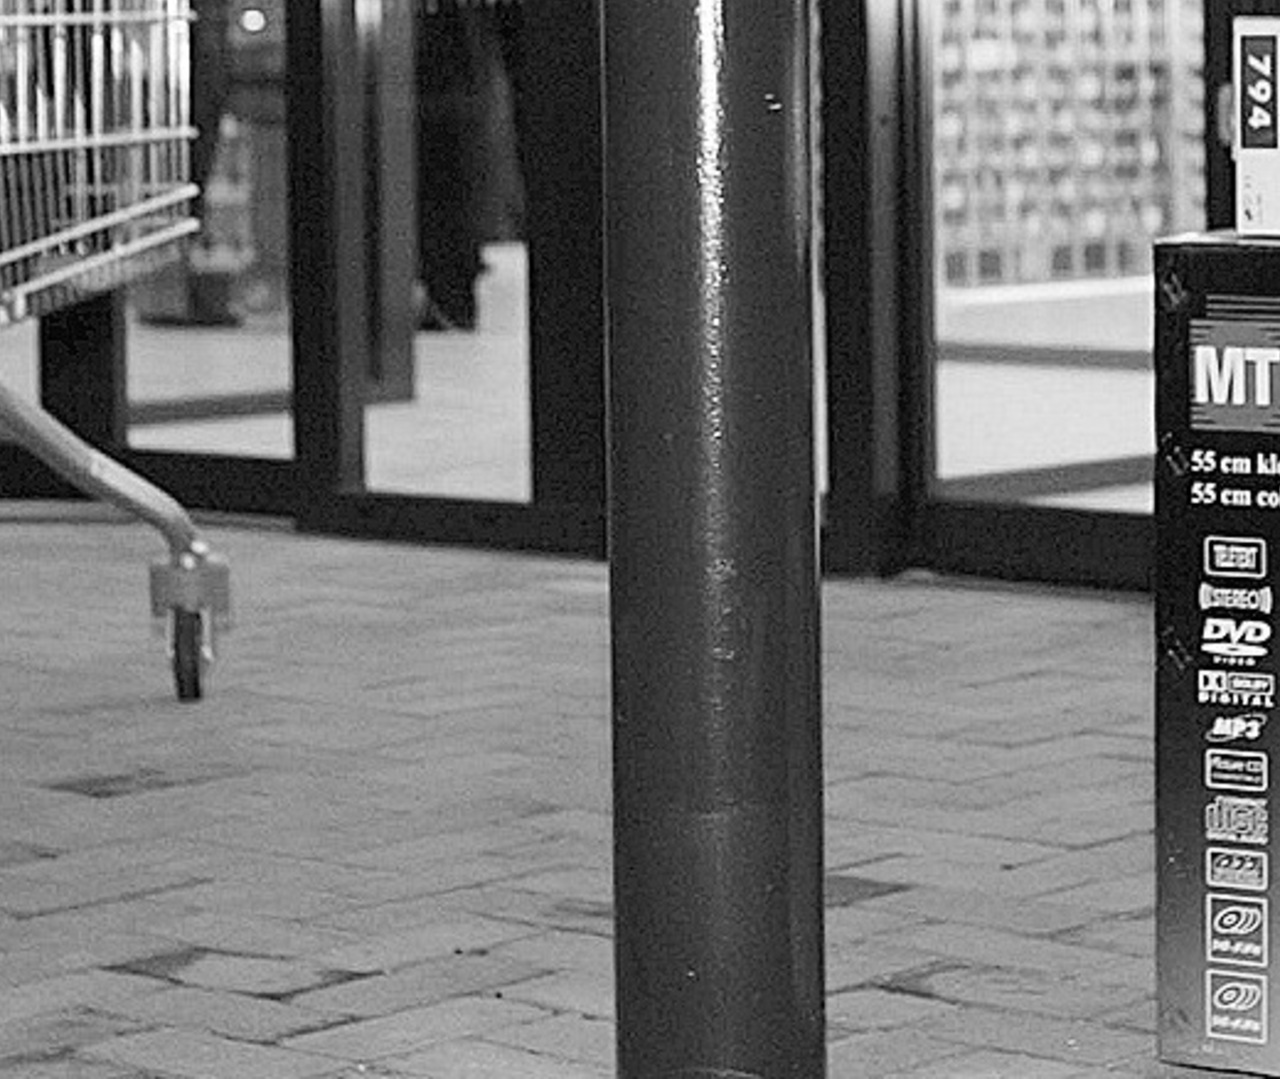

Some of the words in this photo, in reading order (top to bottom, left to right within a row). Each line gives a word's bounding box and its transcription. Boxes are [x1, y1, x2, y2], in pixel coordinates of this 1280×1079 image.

[1247, 54, 1272, 130] 794
[1190, 449, 1217, 472] 55
[1220, 455, 1252, 475] cm
[1190, 482, 1217, 504] 55
[1220, 488, 1252, 507] cm
[1212, 588, 1260, 610] STEREO
[1202, 617, 1272, 645] DVD
[1197, 690, 1275, 708] DIGITAL
[1212, 716, 1261, 739] MP3
